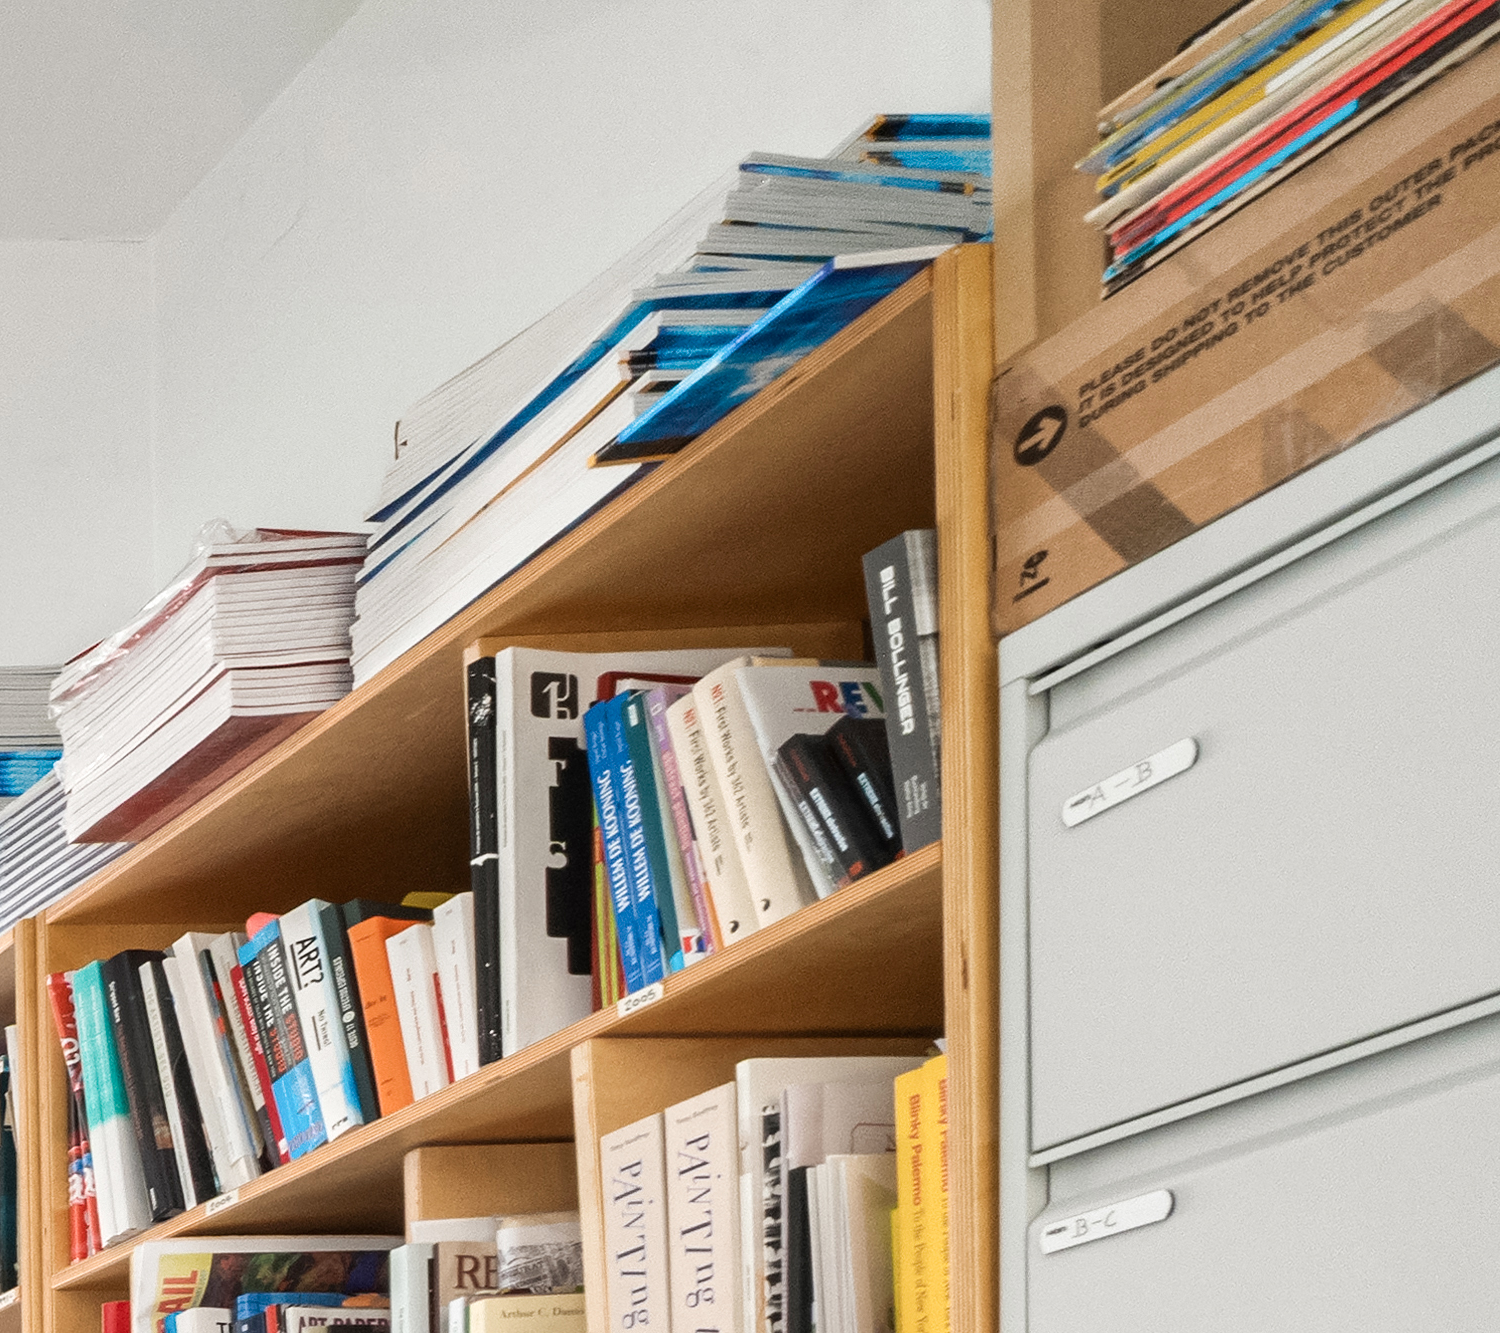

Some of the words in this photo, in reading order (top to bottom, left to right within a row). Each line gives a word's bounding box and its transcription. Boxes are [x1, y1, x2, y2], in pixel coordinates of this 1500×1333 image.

[1077, 391, 1099, 412] IT
[1120, 320, 1218, 389] DESIGNED
[1220, 302, 1248, 326] TO
[1250, 267, 1306, 313] HELP
[1307, 207, 1406, 278] PROTECT
[1415, 172, 1458, 206] THE
[1078, 347, 1146, 397] PLEASE
[1150, 327, 1178, 352] DO
[1181, 300, 1222, 336] NOT
[1225, 248, 1310, 309] REMOVE
[1316, 208, 1366, 245] THIS
[1370, 155, 1445, 210] OUTER
[1080, 380, 1150, 428] DURING
[1151, 325, 1240, 386] SHIPPING
[1245, 307, 1270, 329] TO
[1277, 275, 1316, 309] THE
[1322, 195, 1443, 277] CUSTOMER
[880, 564, 900, 616] BILL
[886, 617, 915, 735] BOLLINGER
[717, 706, 729, 731] First
[689, 731, 702, 759] First
[722, 734, 736, 763] Works
[622, 760, 638, 825] KOONING
[694, 761, 710, 790] Works
[597, 769, 615, 835] KOONING
[608, 838, 620, 857] DE
[631, 827, 644, 848] DE
[614, 860, 631, 913] WILLEM
[637, 851, 652, 903] WILLEM
[266, 944, 283, 986] INSIDE
[295, 936, 326, 989] ART?
[251, 959, 266, 996] INSIDE
[261, 999, 274, 1028] THE
[278, 986, 293, 1012] THE
[285, 1012, 305, 1062] STUDIO
[908, 1094, 921, 1139] Blinky
[911, 1142, 924, 1206] Palermo
